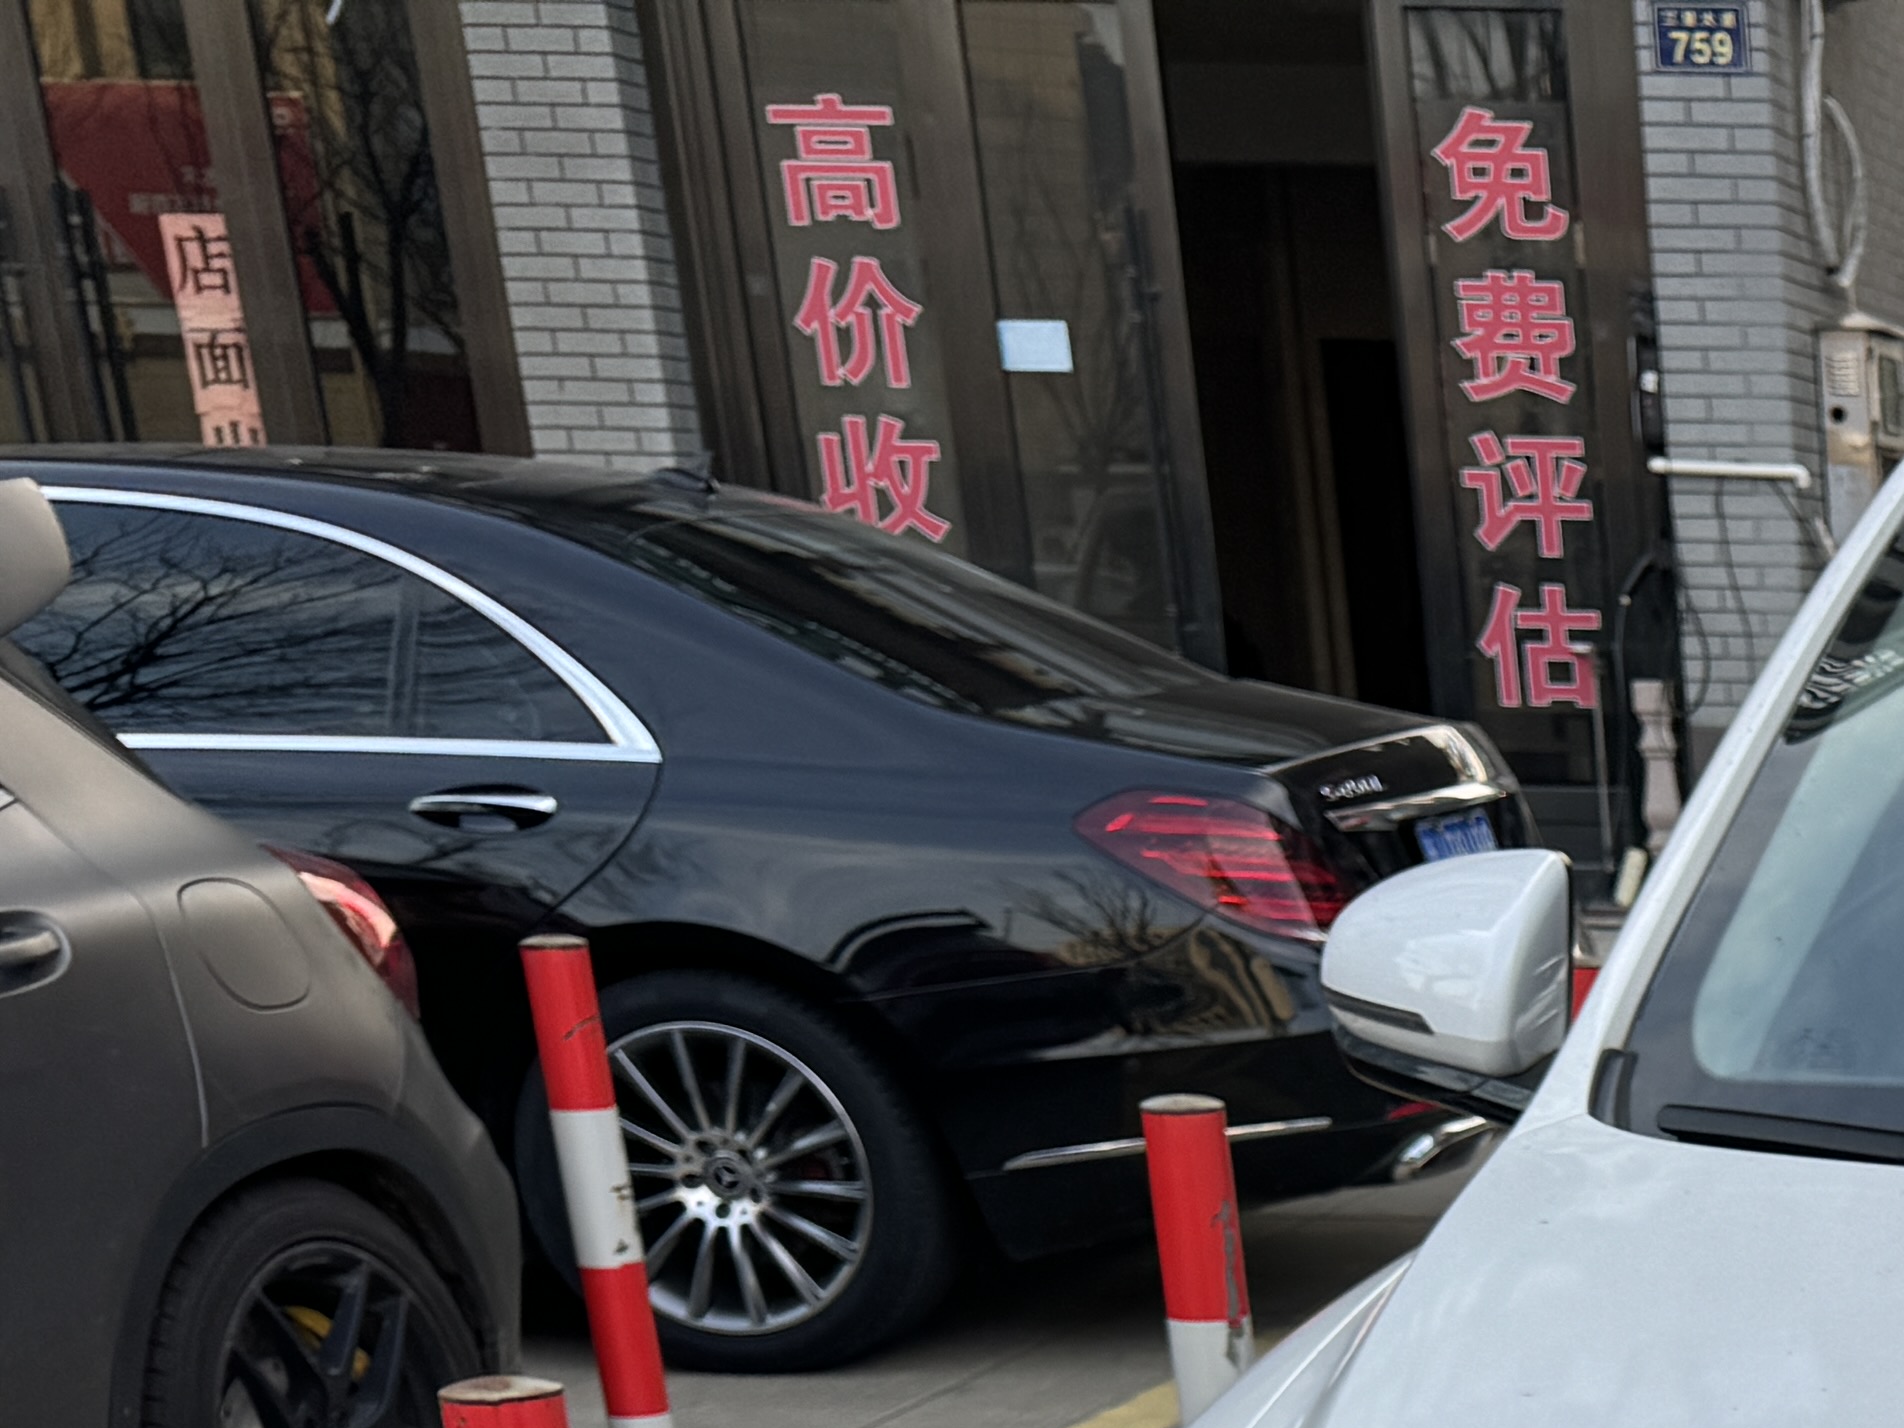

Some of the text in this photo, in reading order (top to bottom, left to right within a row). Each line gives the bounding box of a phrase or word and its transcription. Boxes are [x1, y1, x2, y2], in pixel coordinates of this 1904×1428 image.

[1667, 30, 1734, 65] 759
[175, 224, 260, 447] 店面
[765, 92, 952, 543] 高价收
[1434, 106, 1601, 709] 免费评估
